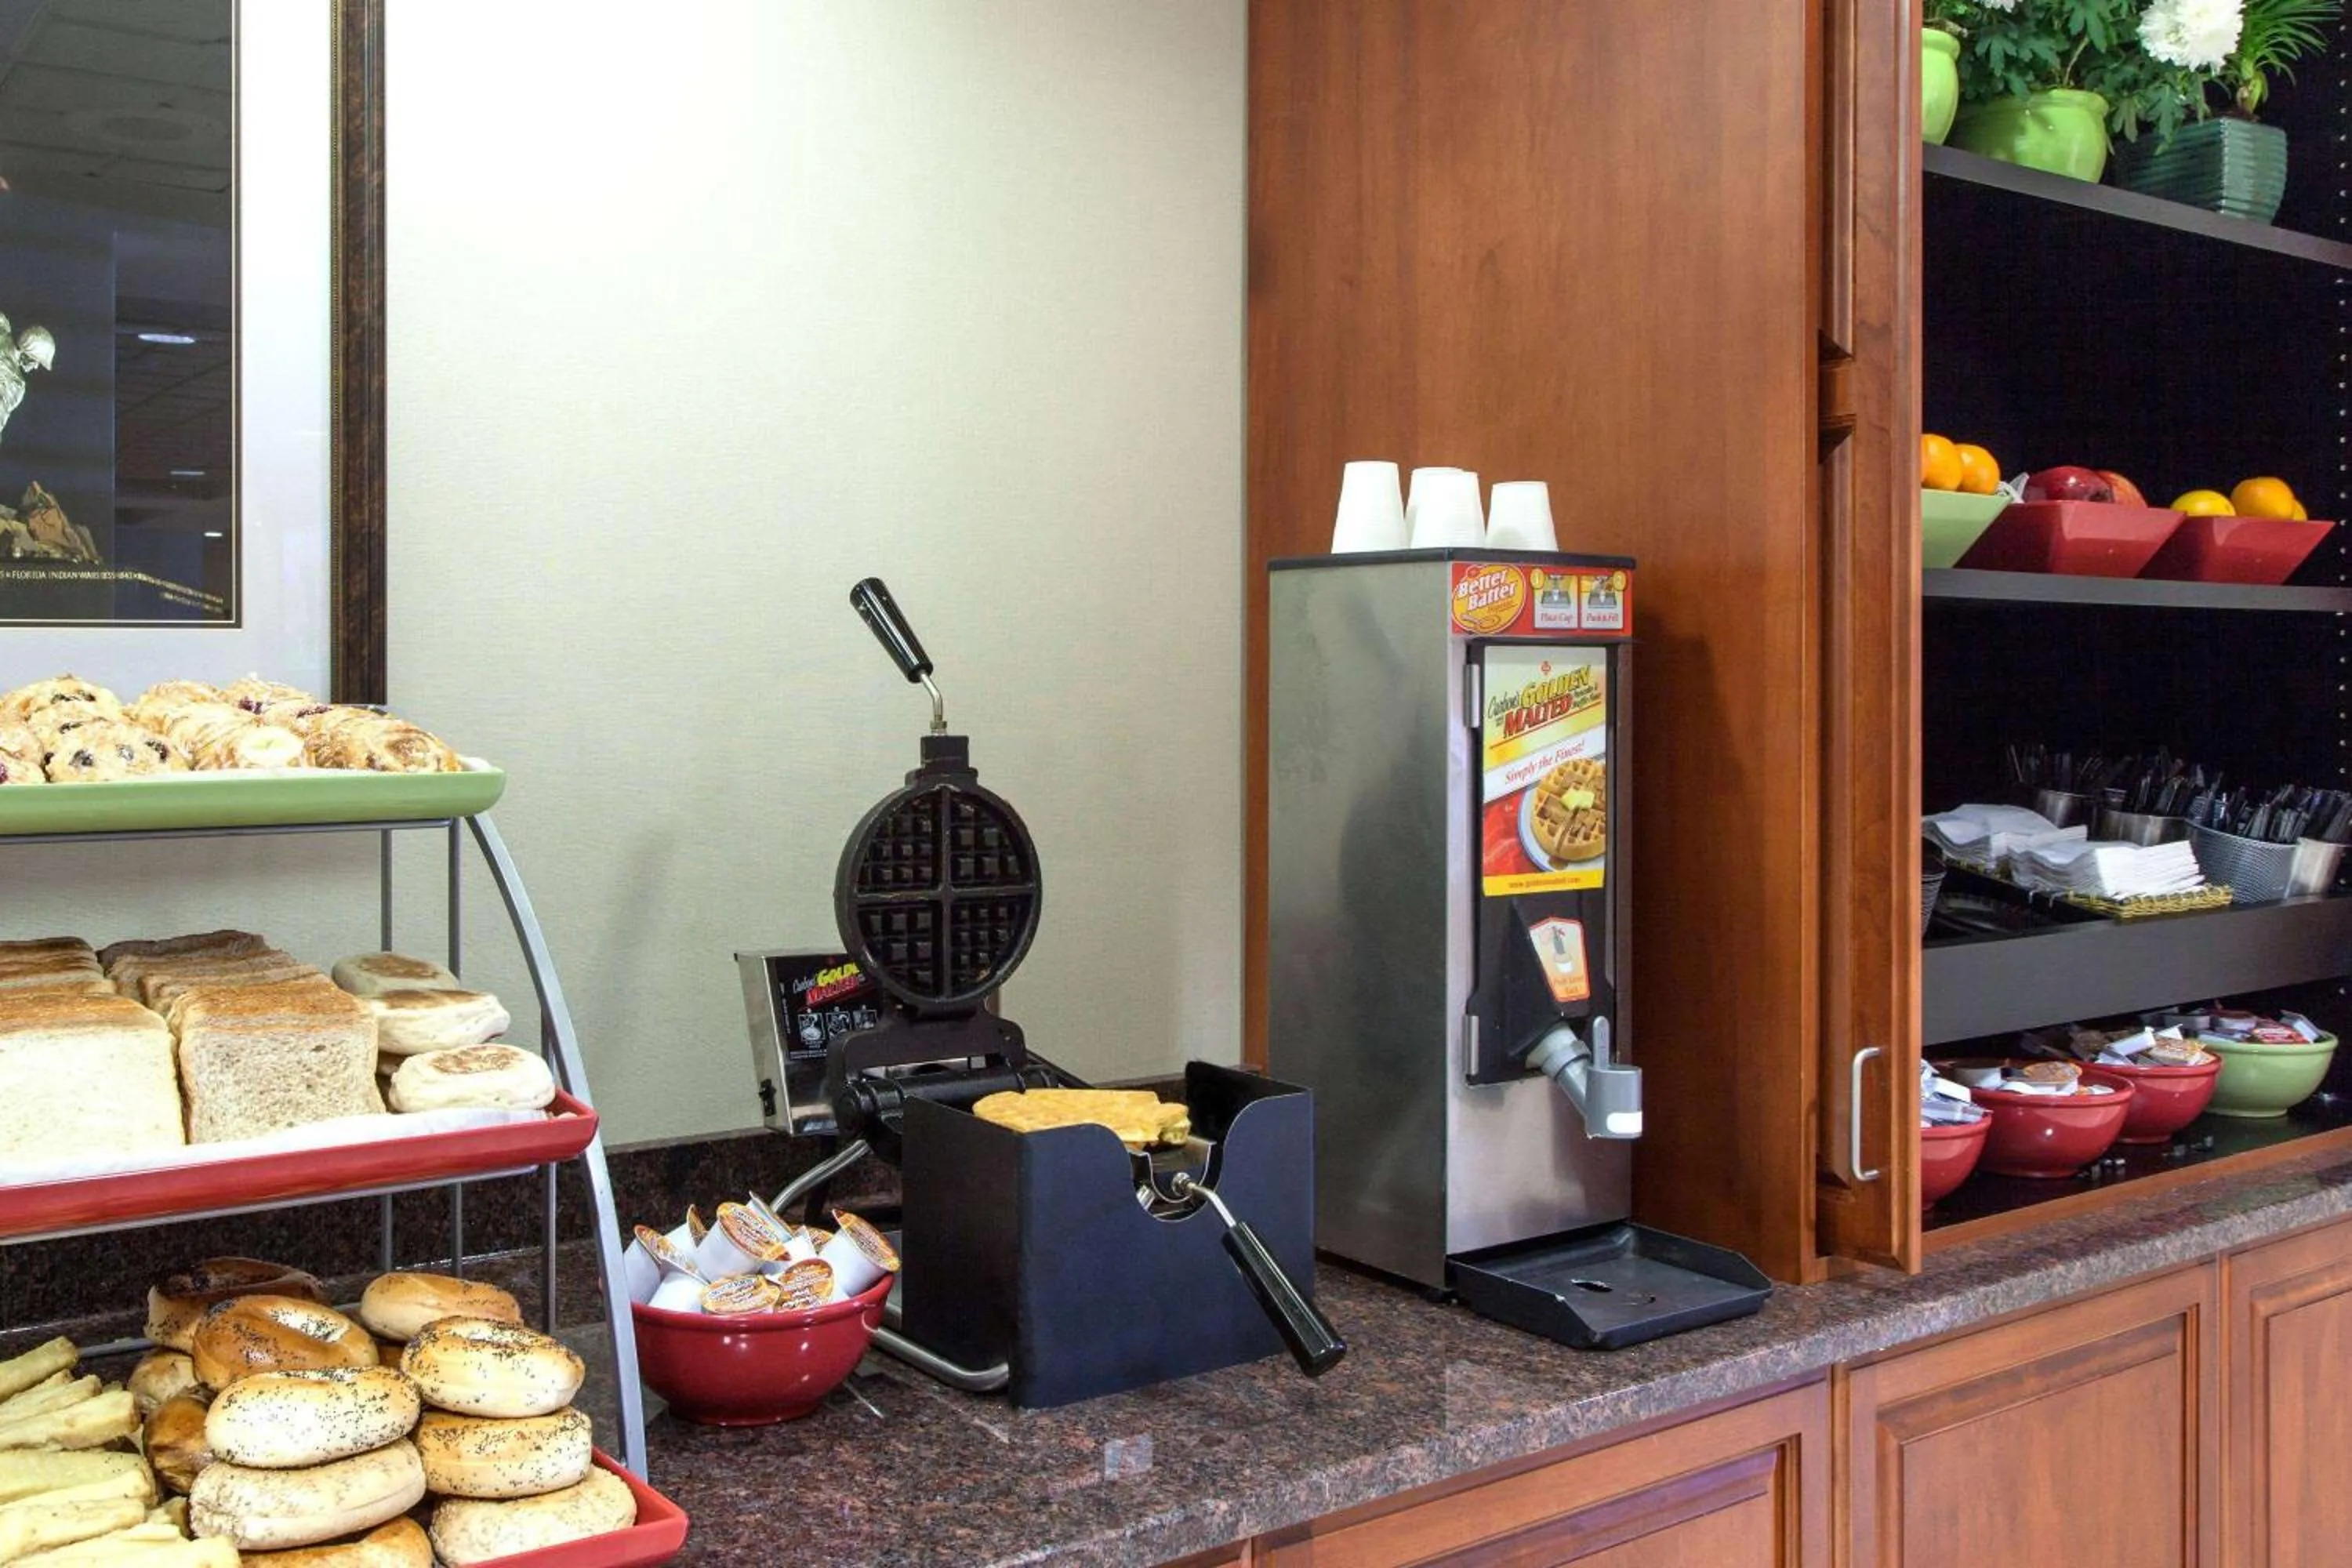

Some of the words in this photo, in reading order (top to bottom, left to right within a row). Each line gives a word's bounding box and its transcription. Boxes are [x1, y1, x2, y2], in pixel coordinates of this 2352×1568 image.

[1457, 569, 1507, 599] Better
[1467, 581, 1516, 610] Batter
[1520, 664, 1591, 709] GOLDEN
[1503, 692, 1573, 739] MALTED
